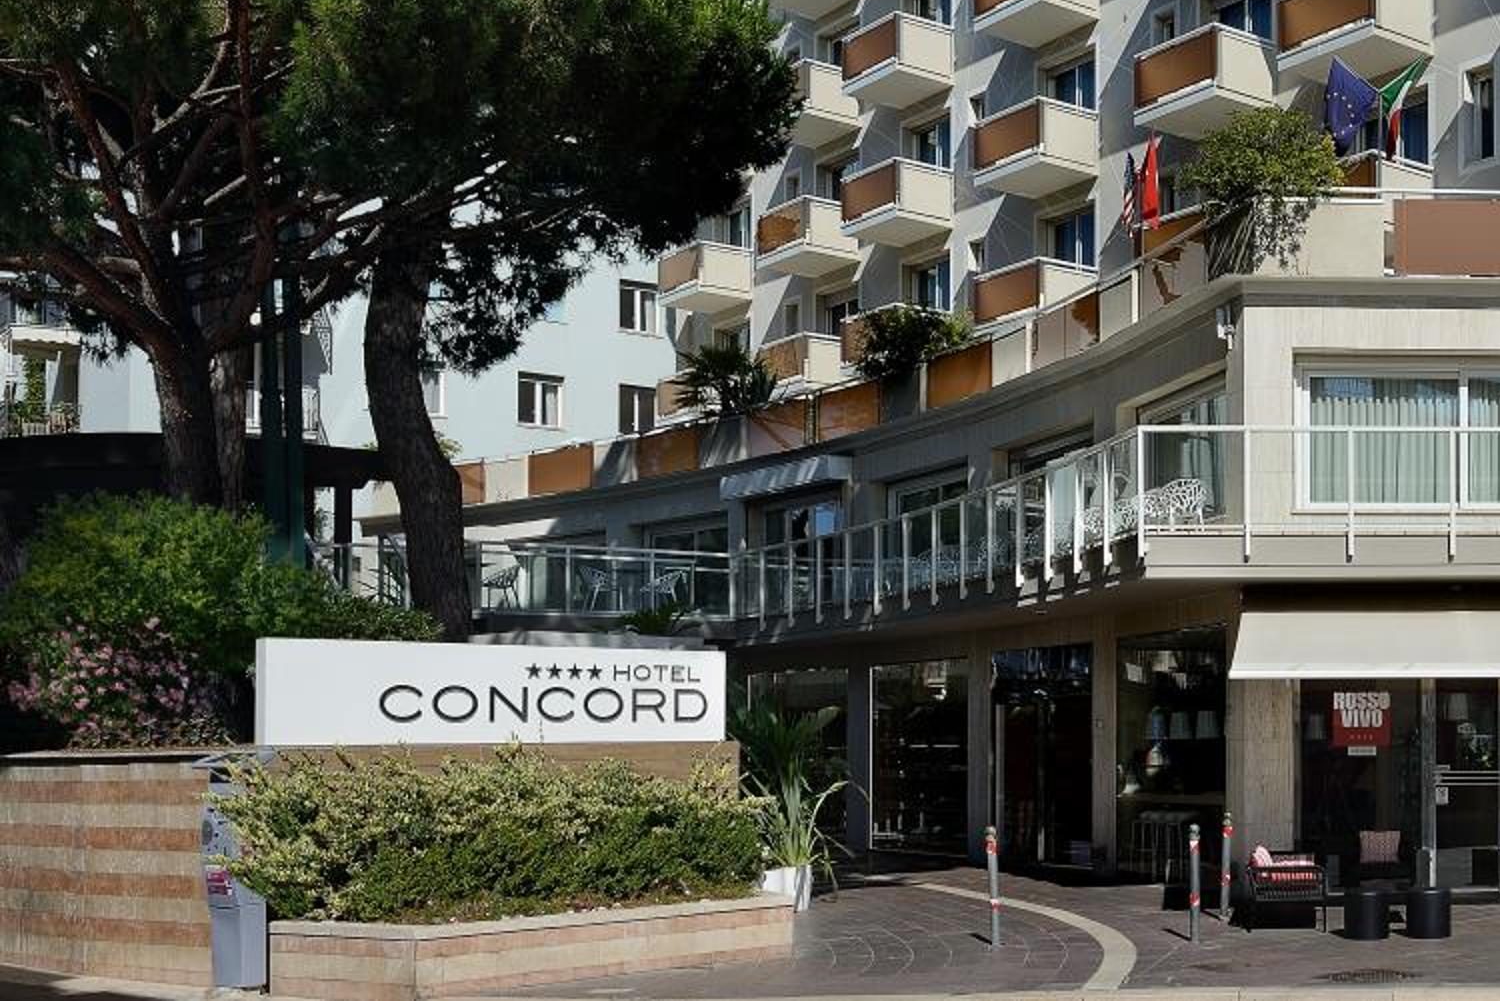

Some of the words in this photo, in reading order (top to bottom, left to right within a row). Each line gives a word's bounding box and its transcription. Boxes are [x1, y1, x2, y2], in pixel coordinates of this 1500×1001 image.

[613, 665, 701, 682] HOTEL
[379, 685, 708, 723] CONCORD
[1333, 691, 1391, 710] ROSSO
[1341, 709, 1383, 728] VIVO
